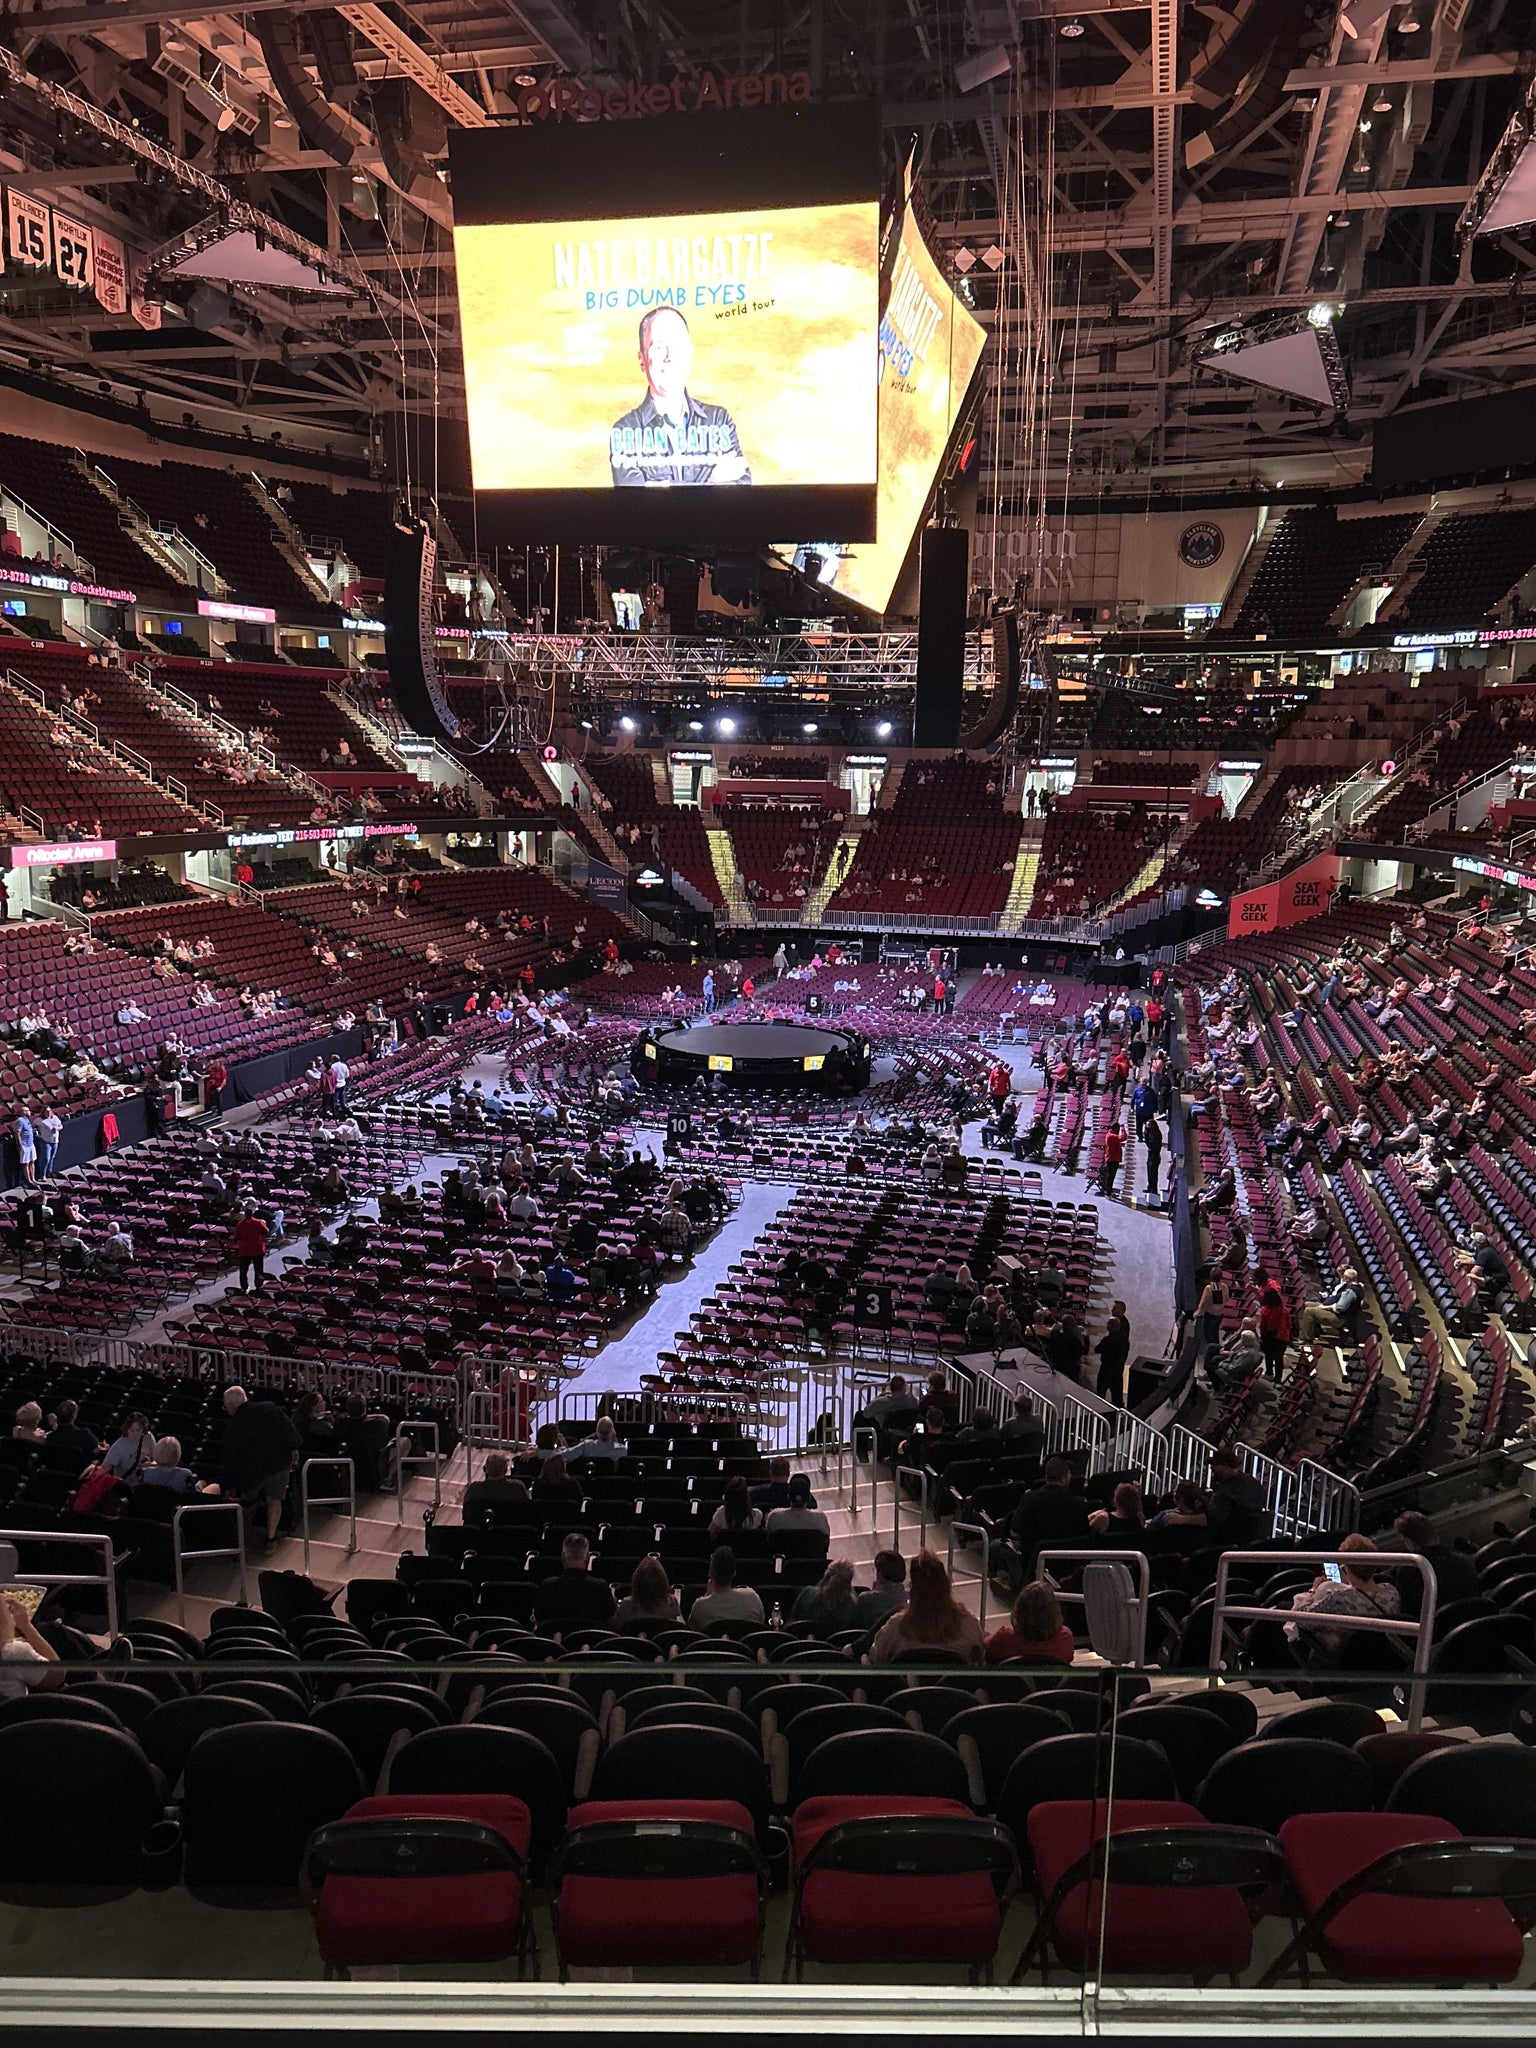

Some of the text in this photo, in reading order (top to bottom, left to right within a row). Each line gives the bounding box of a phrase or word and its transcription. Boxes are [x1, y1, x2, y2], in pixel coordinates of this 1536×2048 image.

[551, 70, 812, 121] Rocket Arena
[16, 214, 45, 262] 15
[59, 236, 89, 283] 27
[553, 232, 774, 288] NATE BARGATZE
[585, 283, 747, 310] BIG DUMB EYES
[714, 298, 776, 321] world tour
[611, 424, 732, 454] BRIAN BATES
[41, 575, 68, 591] TWEET
[70, 582, 136, 603] @RocketArenaHelp
[1394, 635, 1411, 646] For
[1412, 634, 1454, 645] Assistance
[1455, 632, 1477, 642] TEXT
[276, 830, 295, 842] TEXT
[364, 823, 418, 837] @RocketArenaHelp
[36, 846, 104, 861] Rocket Arena
[1295, 881, 1321, 894] SEAT
[1242, 903, 1268, 912] SEAT
[1292, 894, 1321, 907] GEEK
[1240, 912, 1268, 922] GEEK
[943, 952, 950, 961] 7
[1021, 955, 1028, 964] 6
[810, 997, 818, 1008] 5
[670, 1118, 688, 1133] 10
[26, 1209, 34, 1227] 1
[865, 1293, 880, 1314] 3
[199, 1351, 212, 1375] 2
